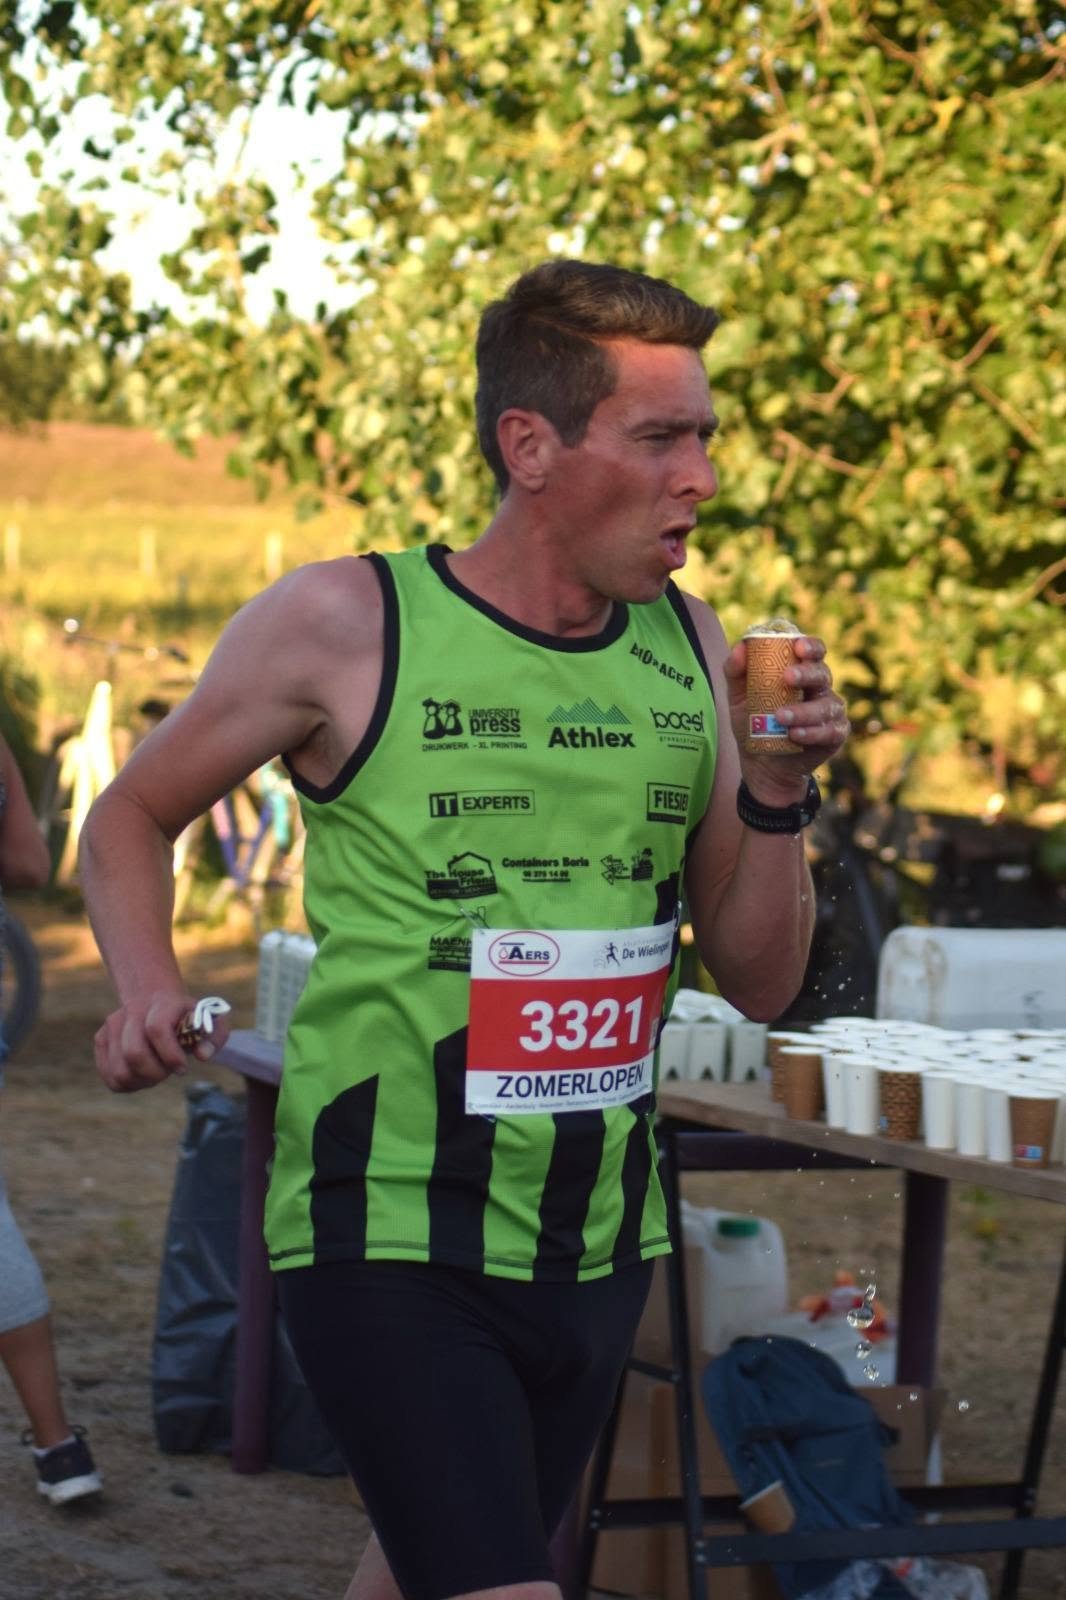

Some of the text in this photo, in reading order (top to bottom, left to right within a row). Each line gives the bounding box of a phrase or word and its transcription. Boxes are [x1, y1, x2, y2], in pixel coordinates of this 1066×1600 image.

[468, 708, 520, 719] UNIVERSITY
[470, 718, 521, 736] press
[548, 726, 637, 749] Athlex
[490, 742, 528, 750] PRINTING
[432, 794, 531, 816] IT EXPERTS
[502, 857, 560, 868] Containers
[424, 868, 485, 880] The House
[508, 946, 550, 960] AERS
[622, 948, 635, 959] De
[518, 995, 644, 1052] 3321
[496, 1062, 644, 1099] ZOMERLOPEN
